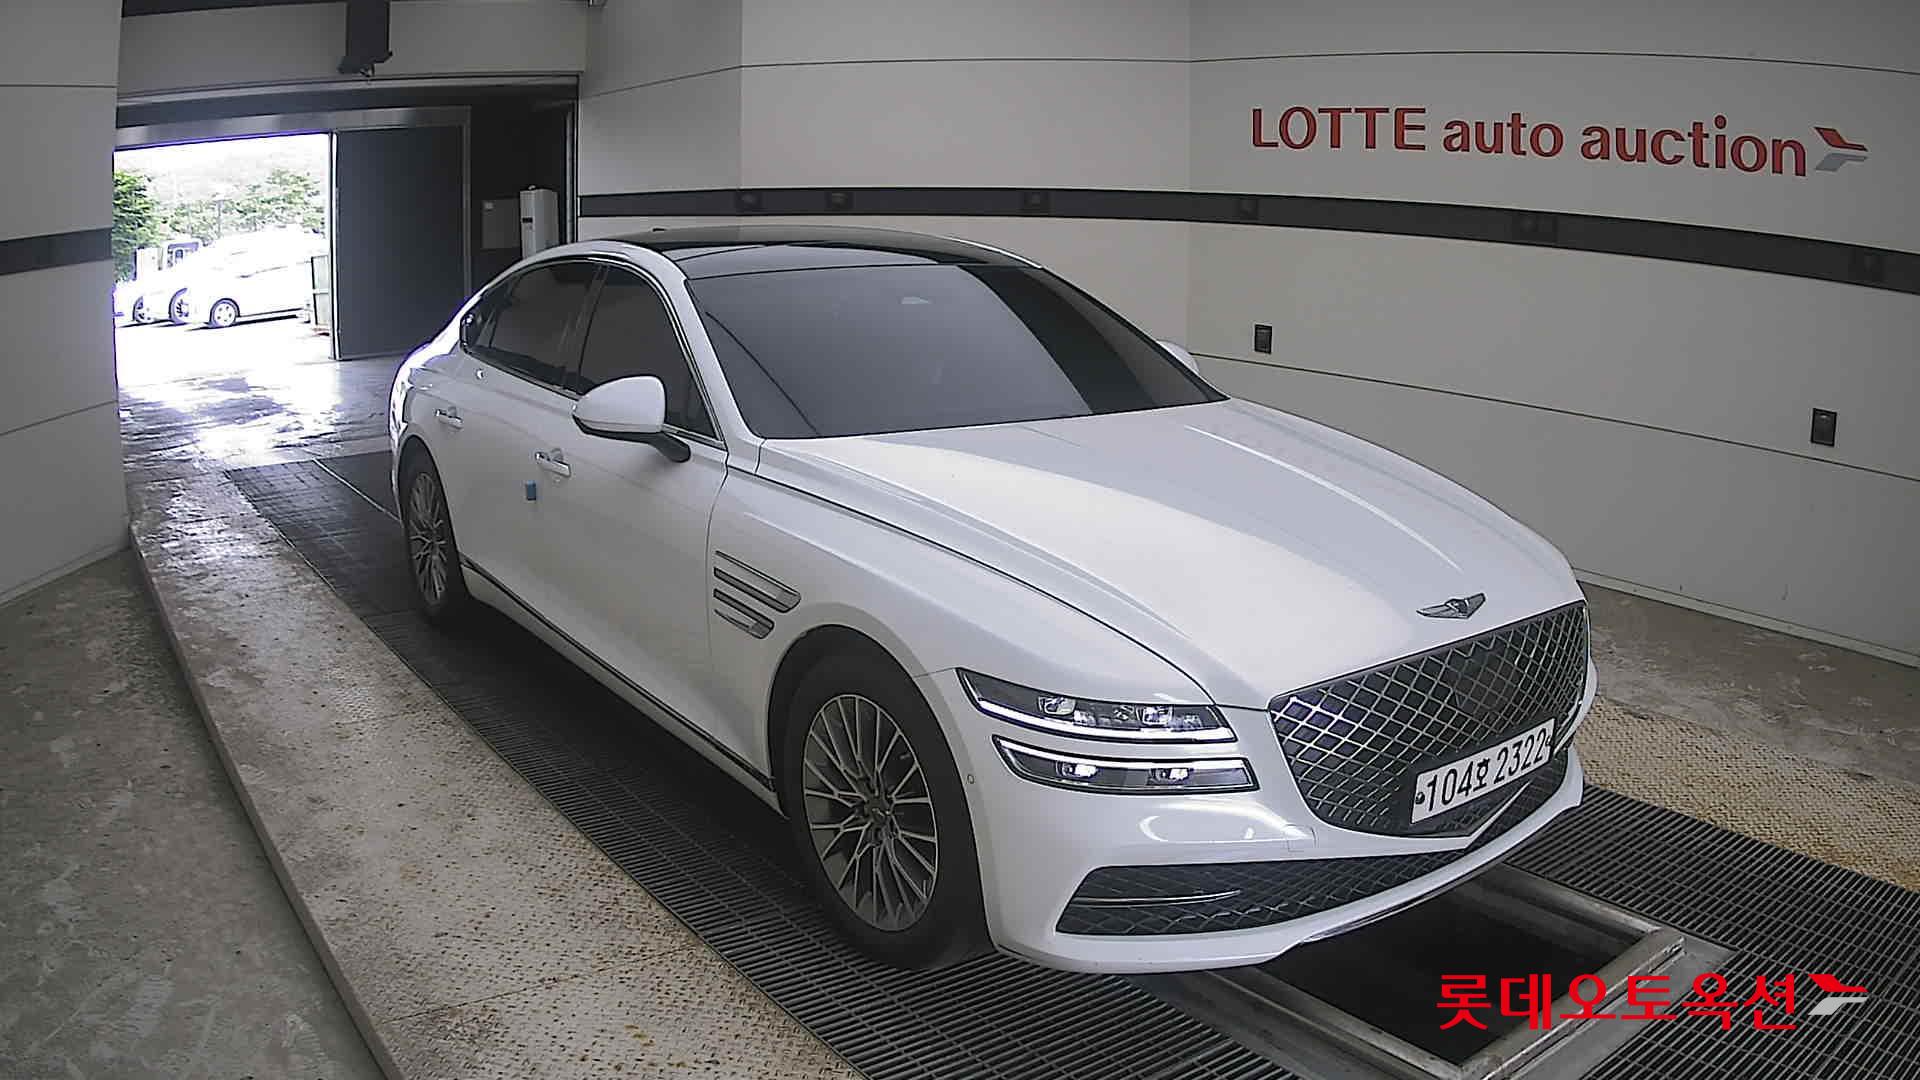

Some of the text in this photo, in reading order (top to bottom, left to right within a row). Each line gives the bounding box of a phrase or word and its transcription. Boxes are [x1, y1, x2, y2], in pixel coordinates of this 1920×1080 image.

[1252, 107, 1807, 177] LOTTE auto auction
[1494, 727, 1547, 785] 2322
